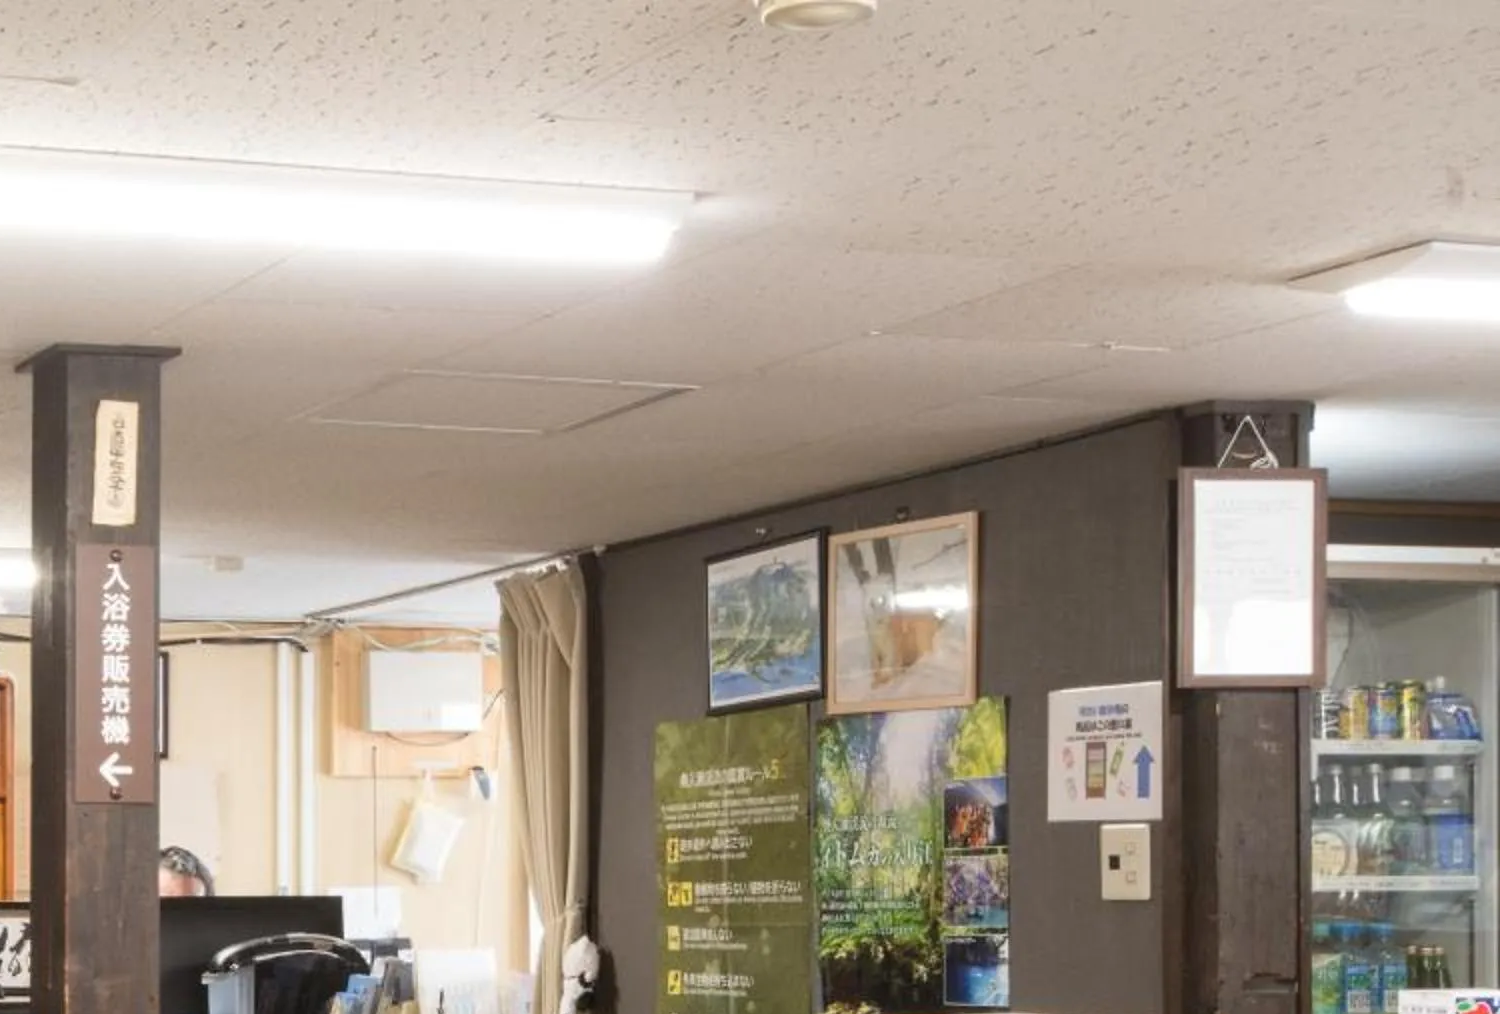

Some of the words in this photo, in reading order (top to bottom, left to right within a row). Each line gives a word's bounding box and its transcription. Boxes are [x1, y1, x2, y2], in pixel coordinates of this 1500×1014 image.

[101, 562, 132, 746] 入浴券販売機
